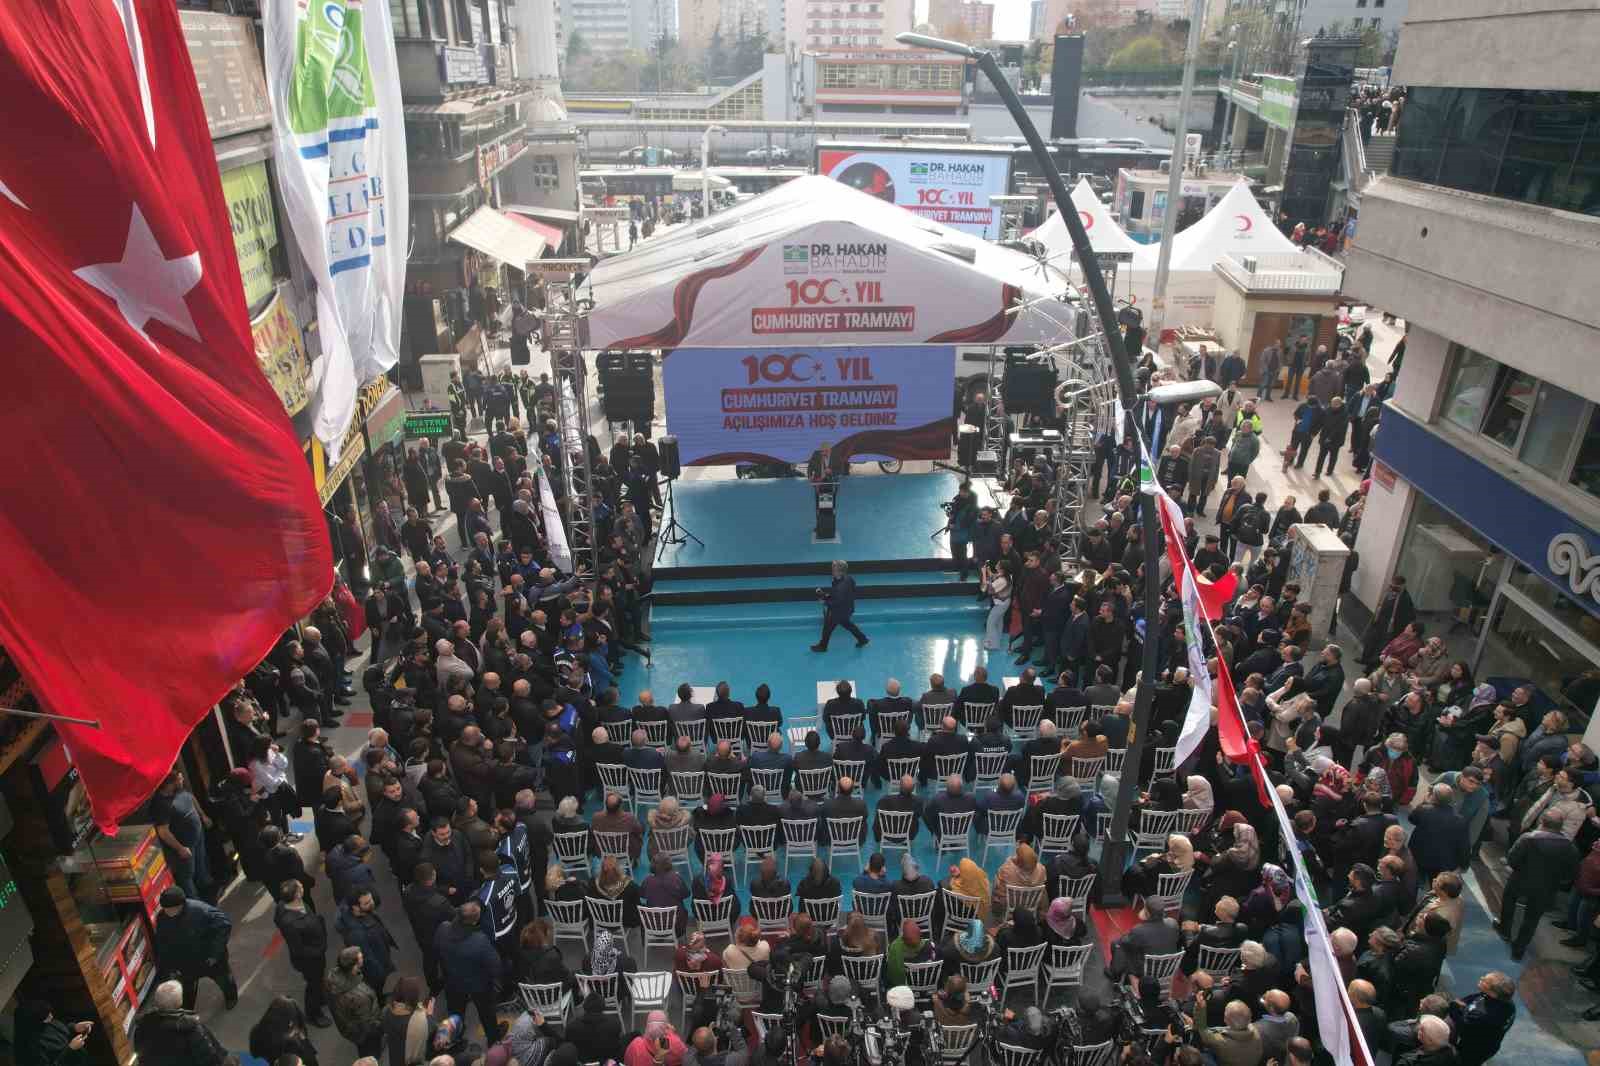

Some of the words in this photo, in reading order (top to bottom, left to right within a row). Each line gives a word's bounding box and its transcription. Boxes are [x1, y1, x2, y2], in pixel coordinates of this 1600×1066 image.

[930, 162, 947, 172] DR.
[948, 163, 985, 174] HAKAN
[958, 191, 974, 205] YIL
[811, 243, 835, 256] DR.
[837, 243, 887, 256] HAKAN
[811, 255, 887, 269] BAHADIR
[855, 280, 883, 304] YIL
[753, 313, 840, 329] CUMHURİYET
[844, 312, 913, 328] TRAMVAYI
[835, 356, 874, 380] YIL
[821, 390, 896, 407] TRAMVAYI
[723, 414, 805, 432] AÇILIŞIMIZA
[808, 414, 837, 430] HOŞ
[839, 412, 897, 428] GELDİNİZ
